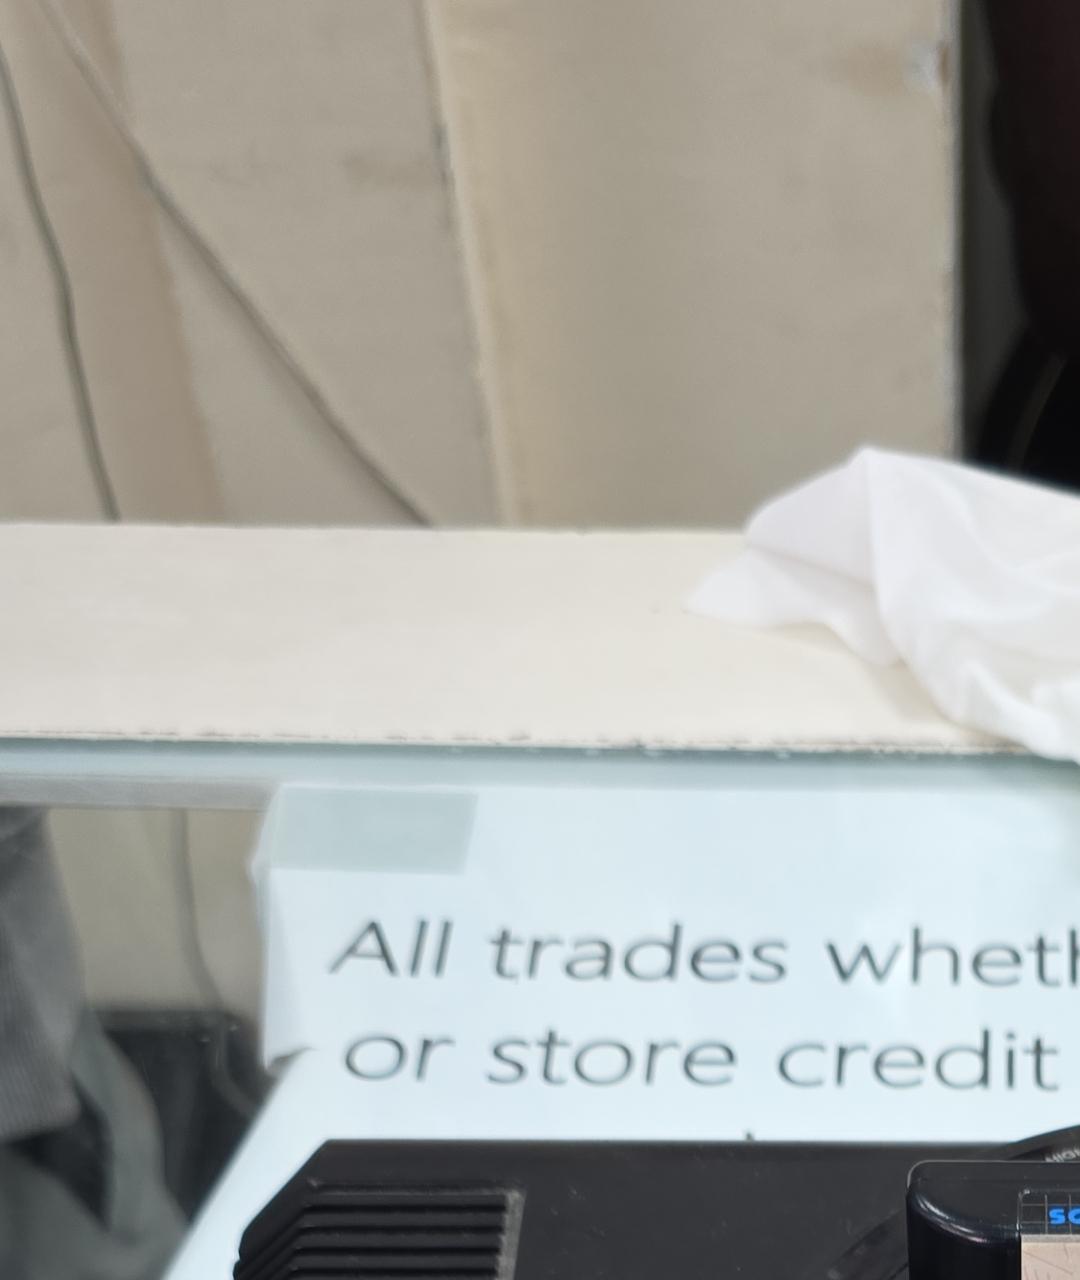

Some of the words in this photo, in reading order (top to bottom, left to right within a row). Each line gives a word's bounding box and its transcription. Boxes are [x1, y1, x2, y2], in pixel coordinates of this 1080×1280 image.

[328, 918, 454, 979] All
[486, 923, 789, 984] trades
[344, 1034, 455, 1083] or
[485, 1029, 738, 1088] store
[776, 1028, 1060, 1094] credit
